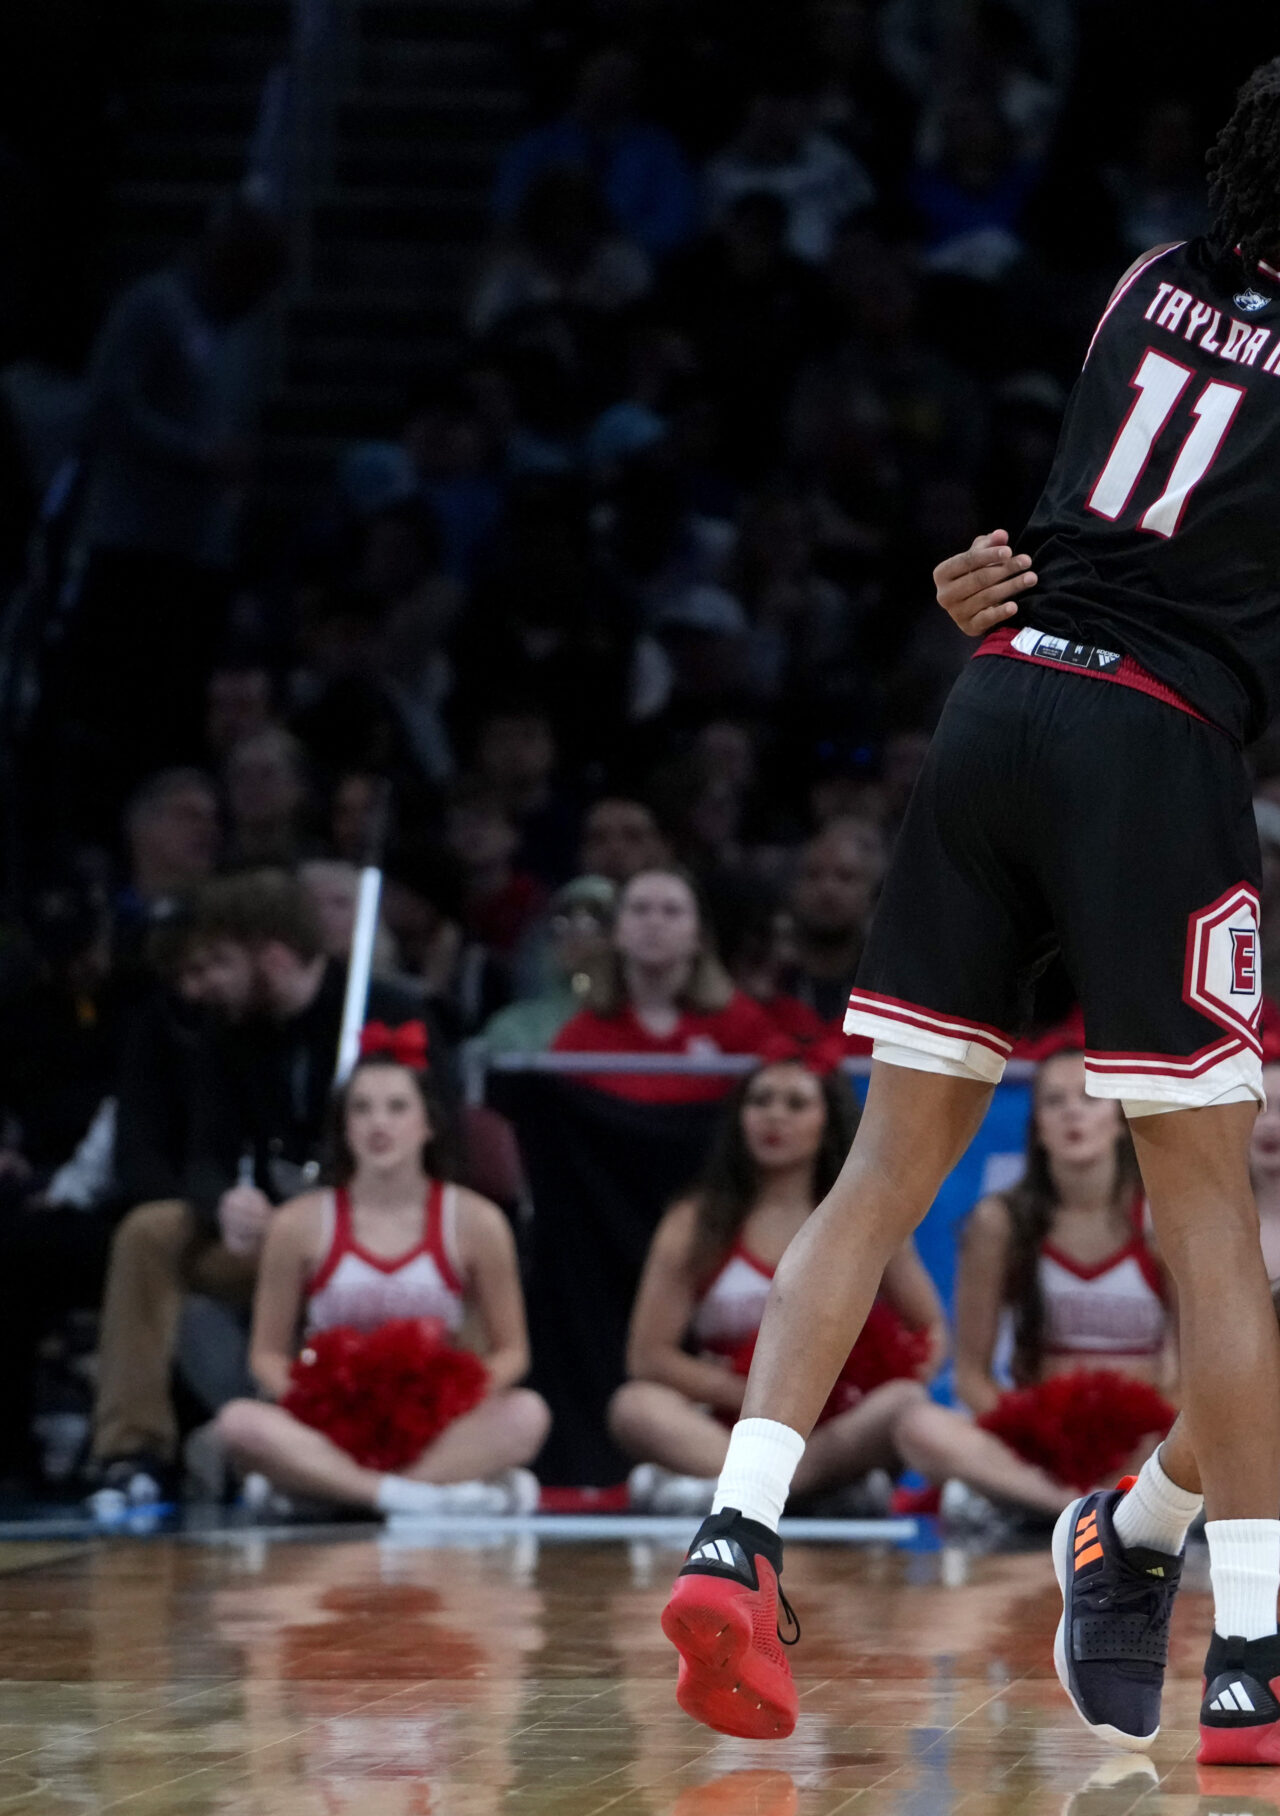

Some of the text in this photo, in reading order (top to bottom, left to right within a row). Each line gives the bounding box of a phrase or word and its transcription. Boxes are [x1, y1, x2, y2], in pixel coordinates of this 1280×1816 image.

[1144, 281, 1271, 367] TAYLOR
[1085, 348, 1247, 539] 11
[1229, 928, 1255, 994] E
